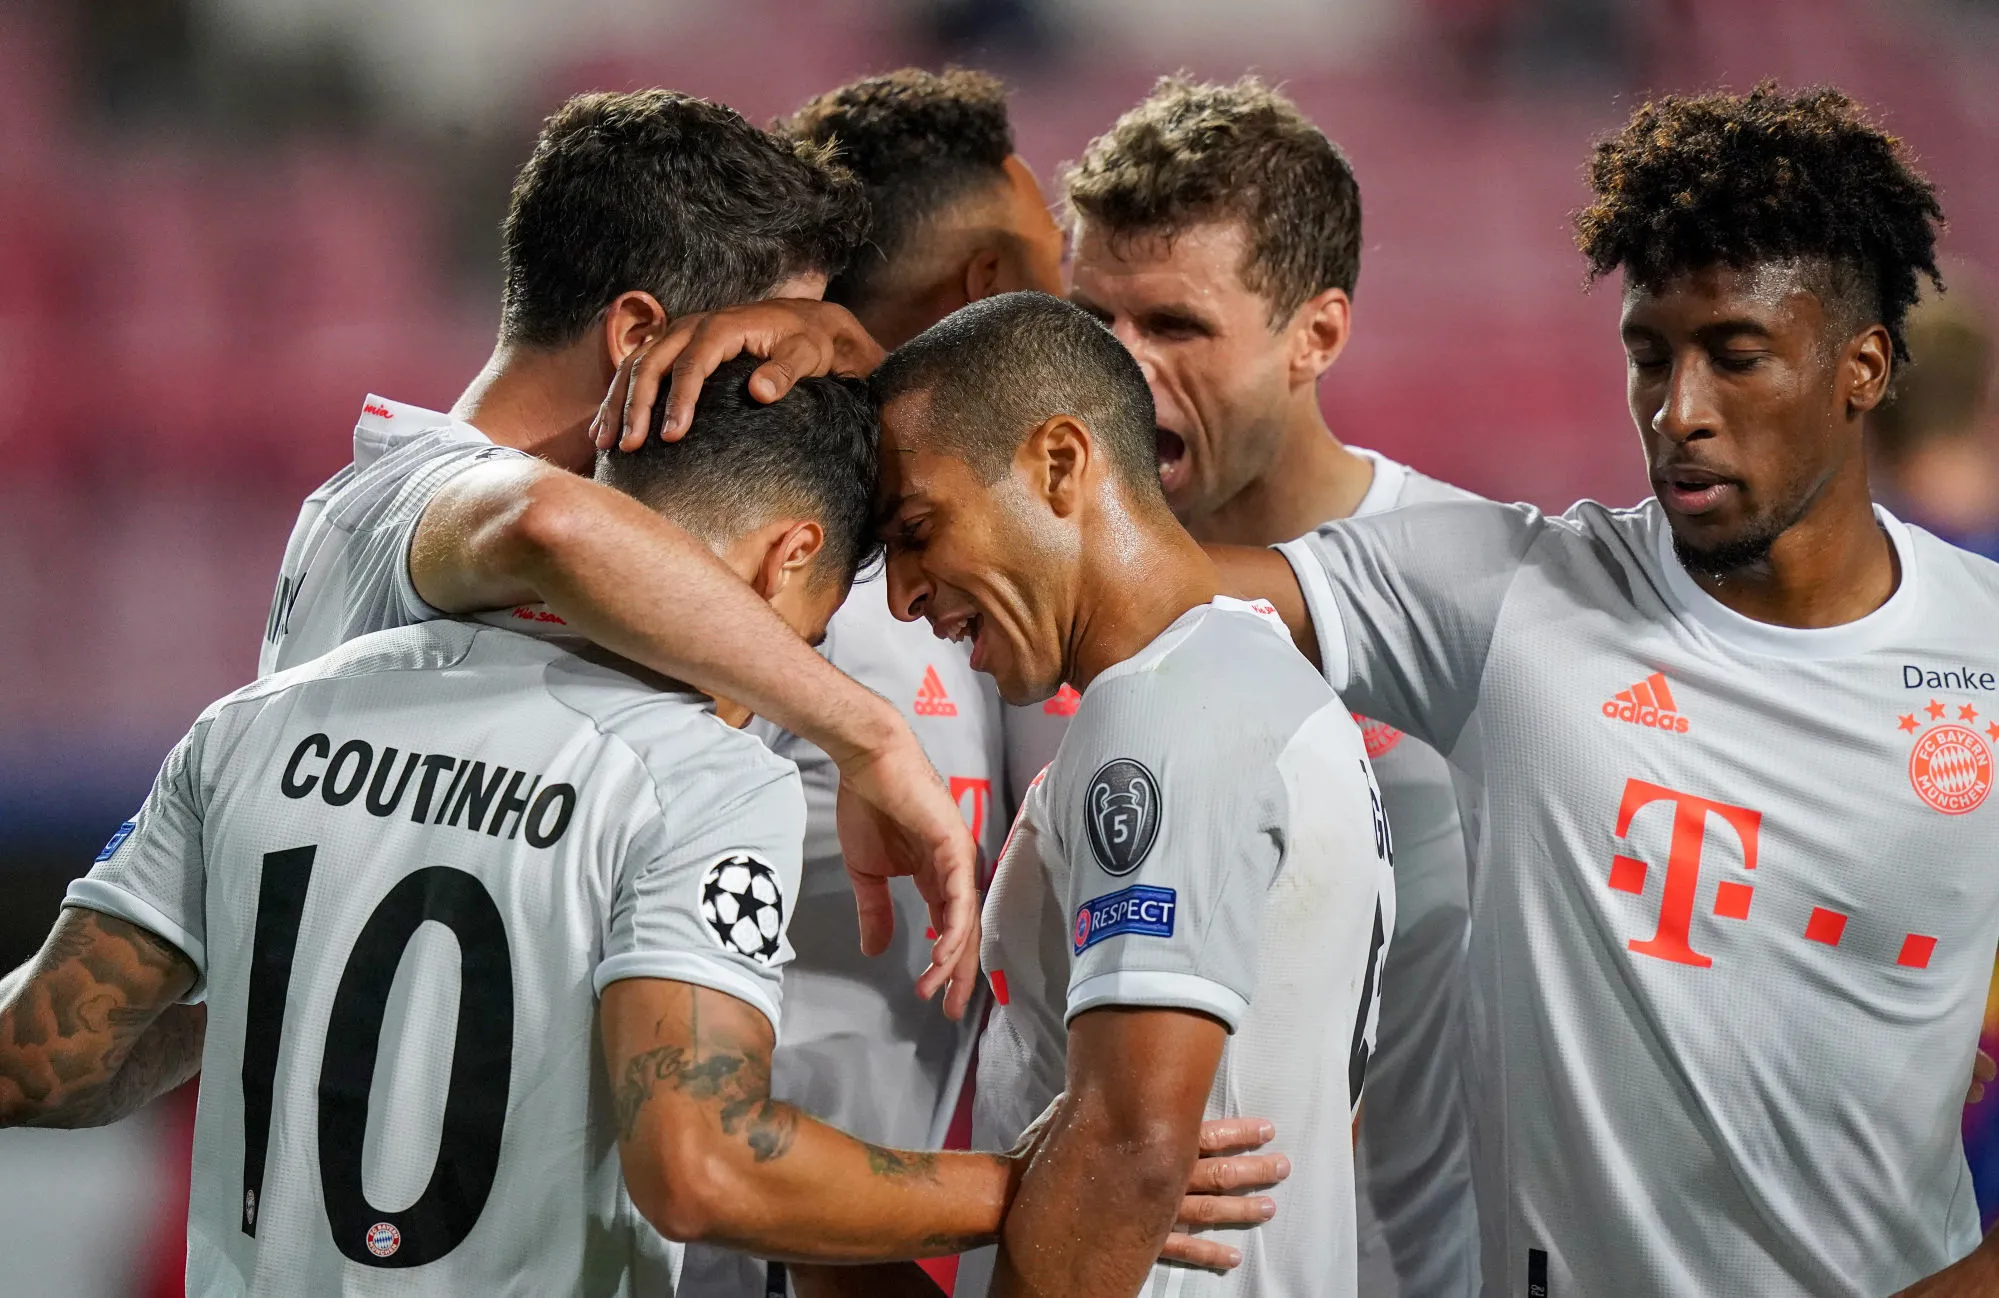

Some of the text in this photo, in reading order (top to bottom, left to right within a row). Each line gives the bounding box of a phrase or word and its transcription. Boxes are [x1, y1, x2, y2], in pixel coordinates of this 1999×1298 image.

[1903, 665, 1996, 691] Danke
[1601, 701, 1690, 734] adidas
[1919, 731, 1988, 767] FC BAYERN
[280, 732, 577, 850] COUTINHO
[1113, 814, 1129, 844] 5
[1091, 899, 1174, 932] RESPECT
[241, 844, 514, 1269] 10
